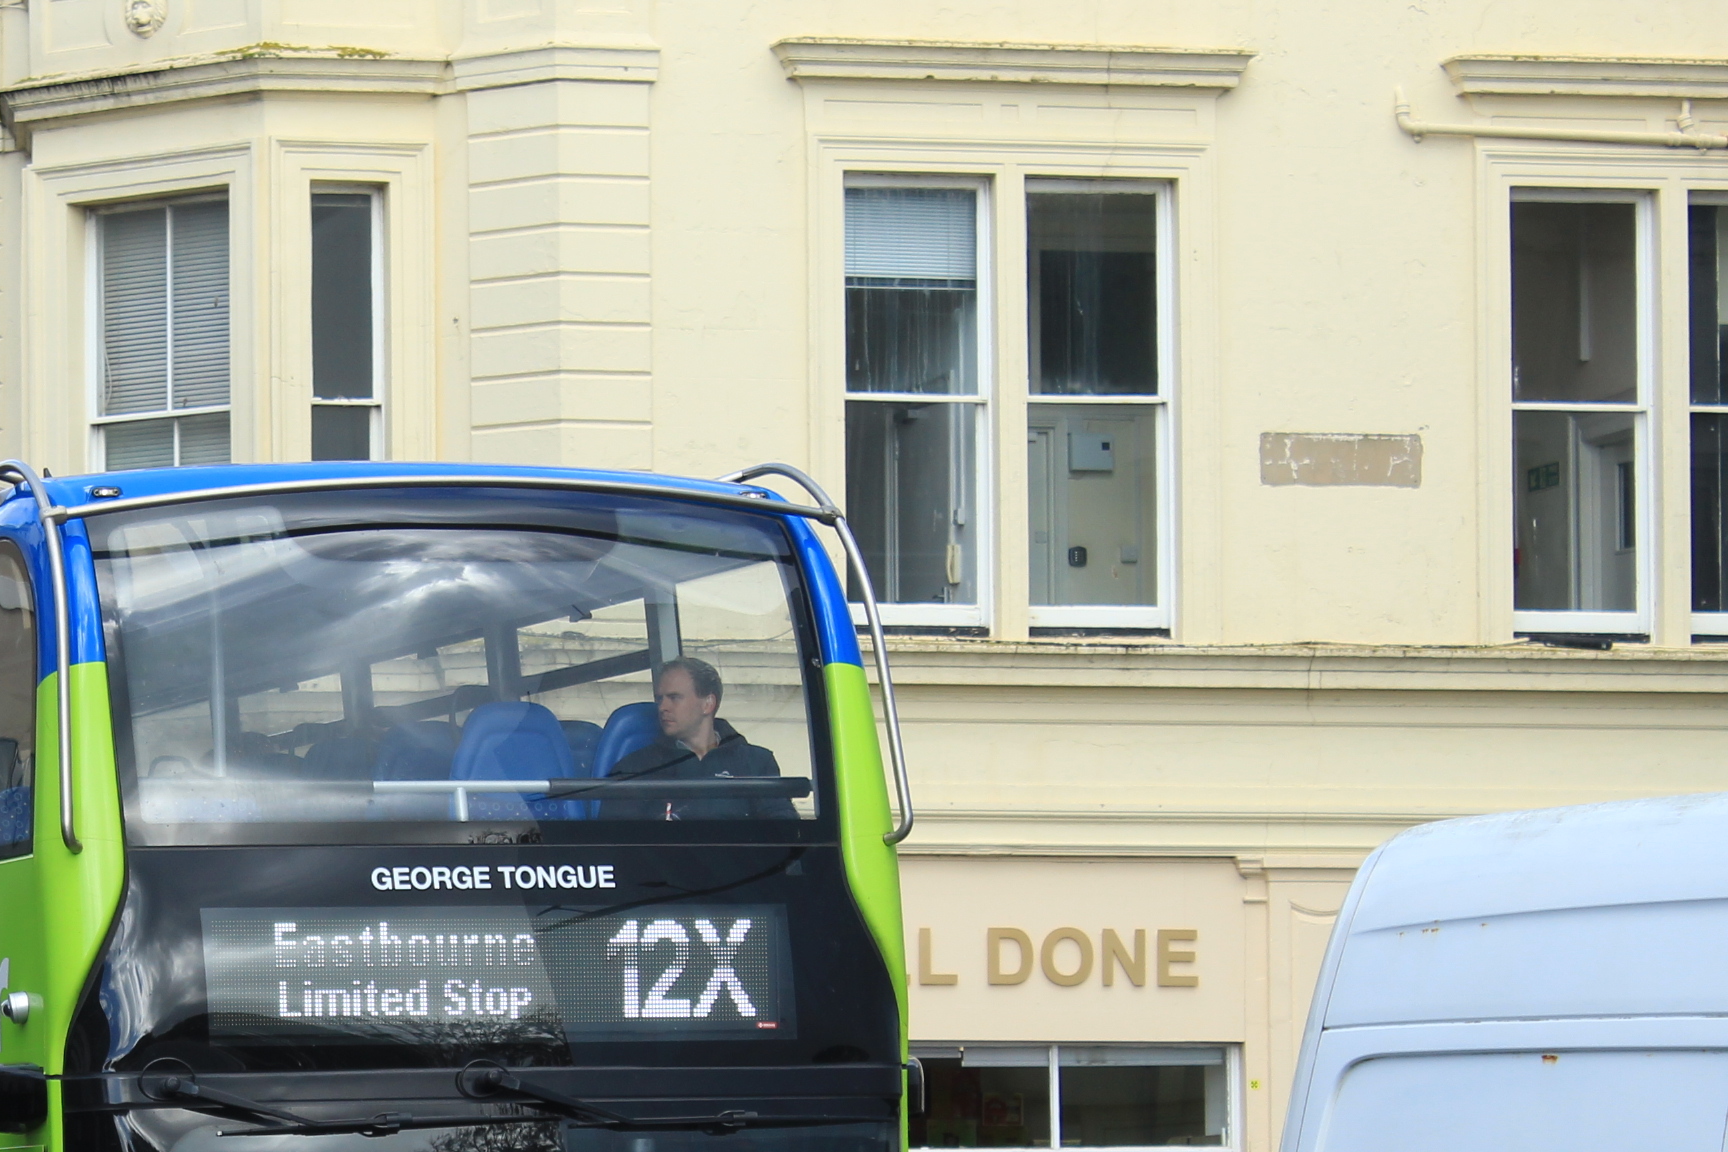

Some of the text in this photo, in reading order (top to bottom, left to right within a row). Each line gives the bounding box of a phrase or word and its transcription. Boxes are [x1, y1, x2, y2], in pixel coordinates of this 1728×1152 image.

[370, 865, 616, 891] GEORGE TONGUE
[273, 922, 536, 968] Eastbourne
[908, 927, 1199, 988] L DONE
[605, 918, 758, 1020] 12X
[278, 979, 532, 1020] Limited Stop
